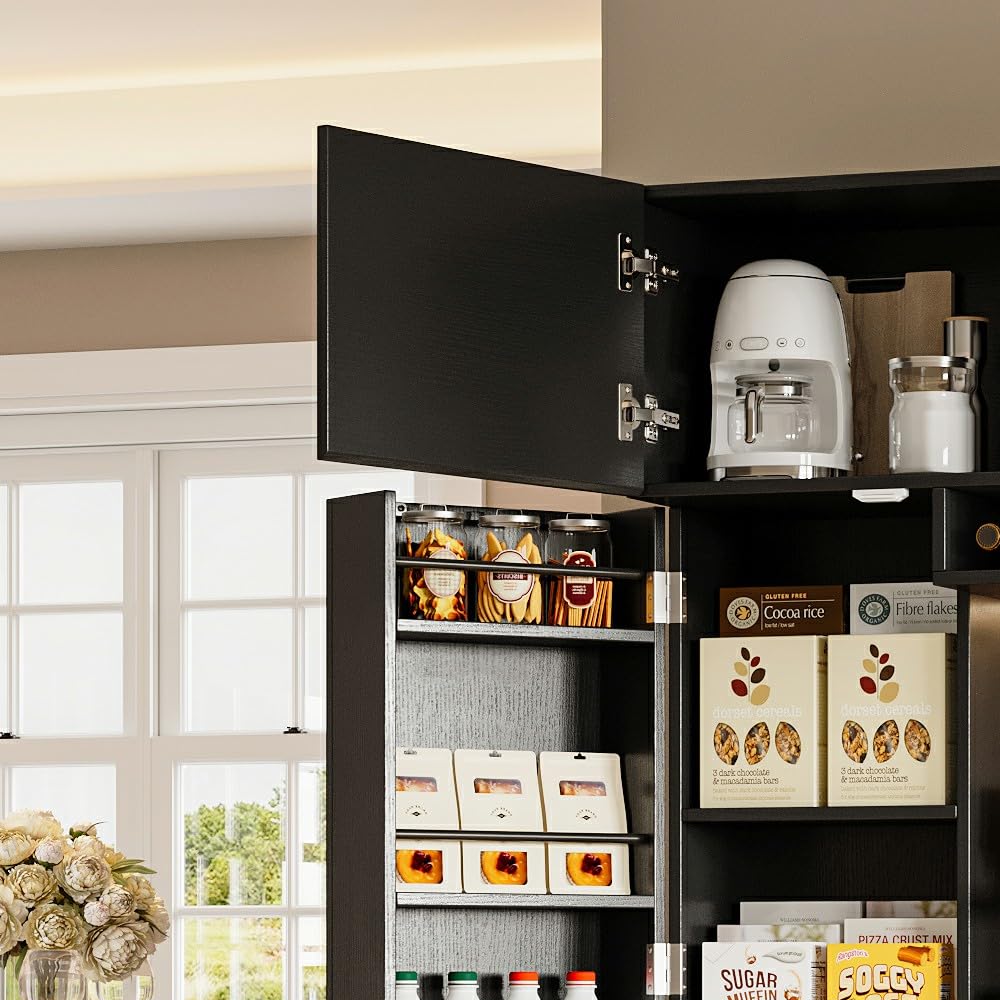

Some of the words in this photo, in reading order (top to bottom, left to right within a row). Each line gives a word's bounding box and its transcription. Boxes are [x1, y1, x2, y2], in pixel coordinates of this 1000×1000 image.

[764, 606, 800, 619] Cocoa
[804, 605, 825, 618] rice
[896, 602, 924, 615] Fibre
[927, 601, 957, 614] flakes
[859, 936, 888, 944] PIZZA
[892, 935, 929, 943] CRUST
[933, 935, 953, 944] MIX
[721, 969, 777, 991] SUGAR
